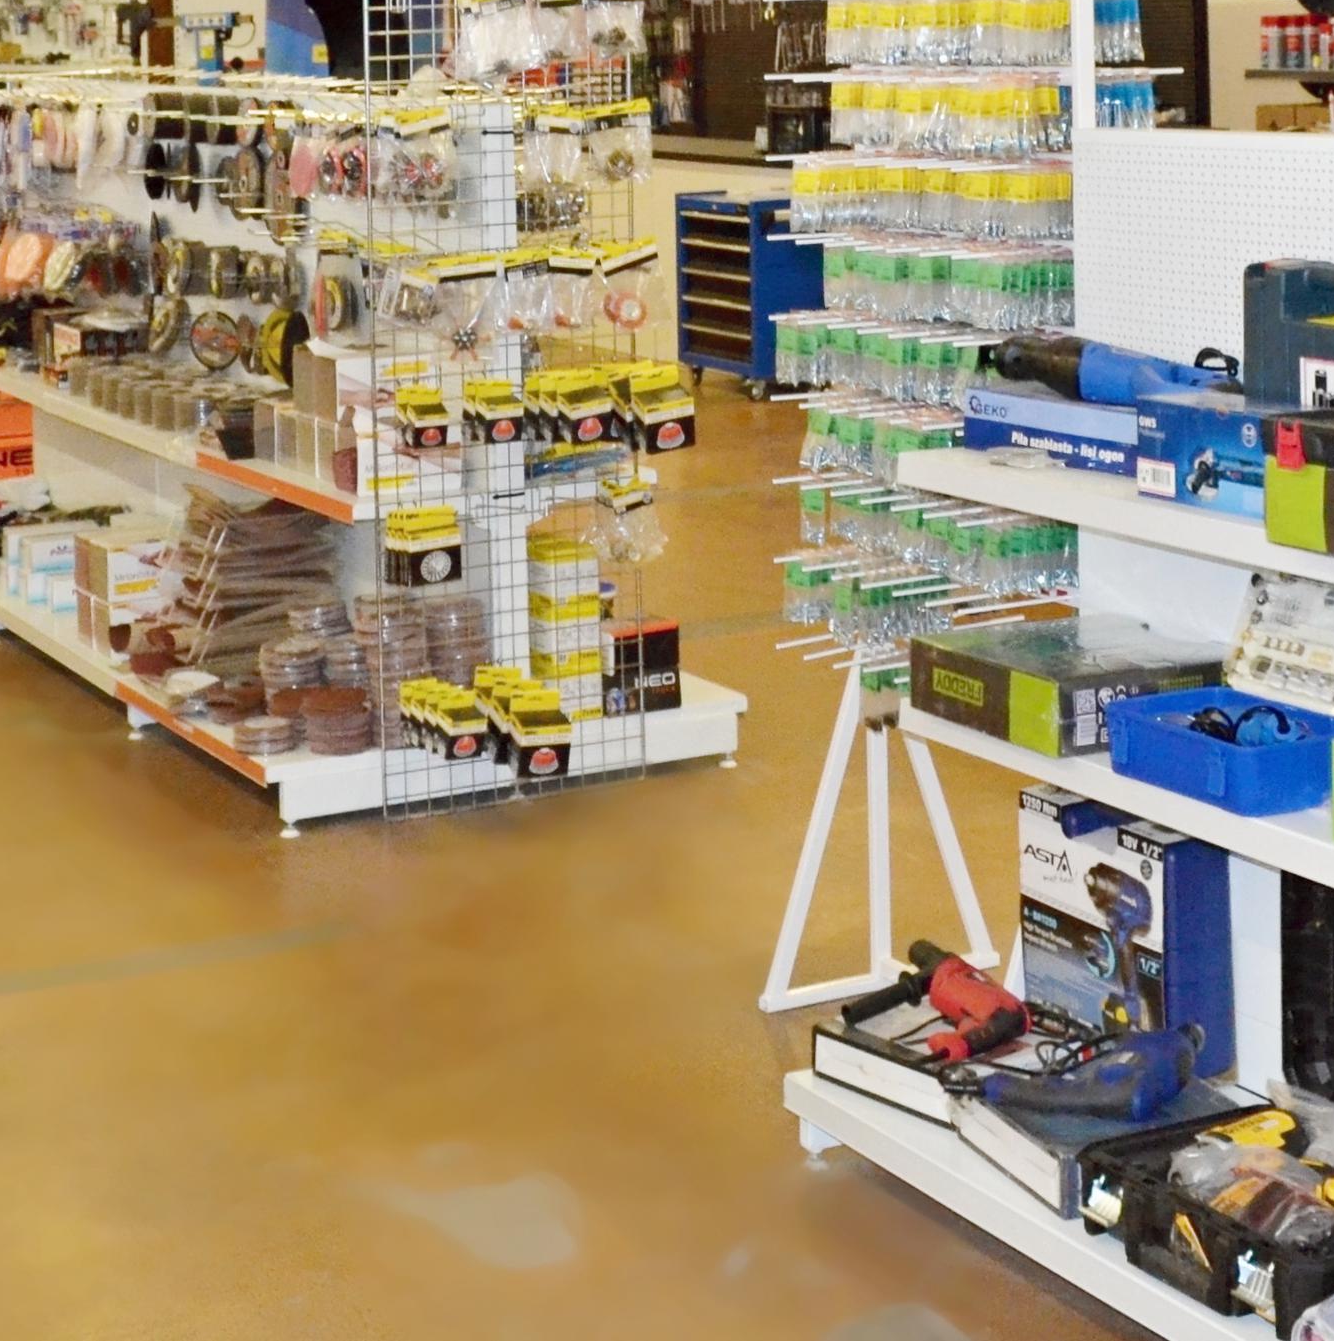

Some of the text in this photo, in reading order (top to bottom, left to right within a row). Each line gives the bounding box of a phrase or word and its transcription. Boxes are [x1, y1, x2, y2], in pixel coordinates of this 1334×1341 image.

[970, 396, 1008, 419] GEKO
[635, 673, 675, 688] NEO
[937, 672, 982, 703] FREDDY
[1022, 793, 1041, 811] 1250
[1024, 844, 1072, 876] ASTA
